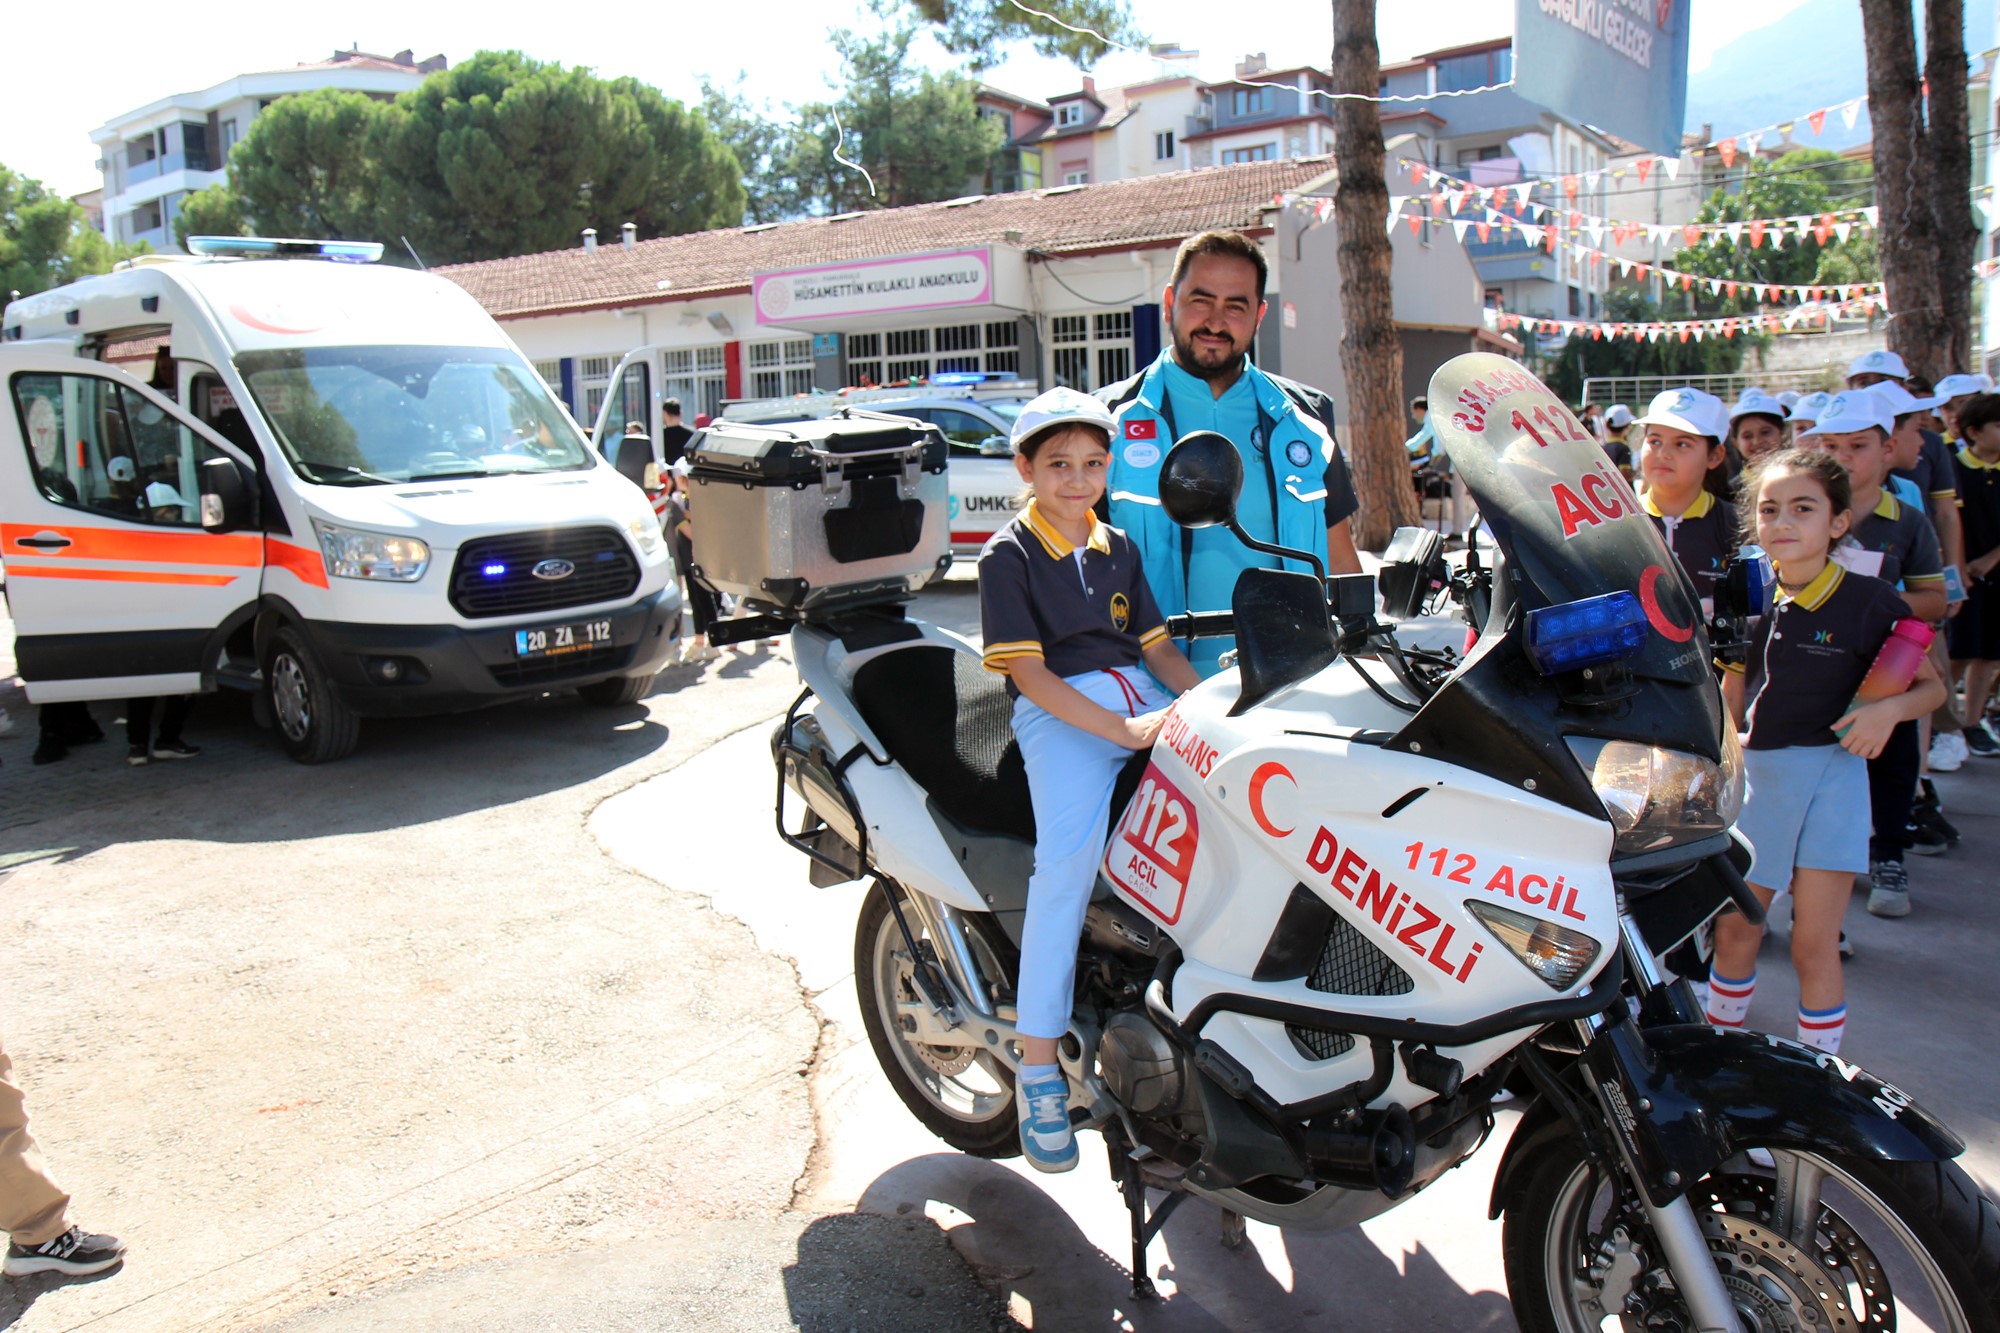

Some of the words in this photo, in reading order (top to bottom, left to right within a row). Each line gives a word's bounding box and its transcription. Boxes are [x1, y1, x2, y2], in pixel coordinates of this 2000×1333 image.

[1604, 9, 1652, 69] GELECEK
[794, 281, 864, 301] HÜSAMETTİN
[866, 276, 916, 295] KULAKLI
[919, 270, 979, 288] ANAOKULU
[1511, 404, 1588, 448] 112
[965, 496, 1018, 511] UMKE
[528, 630, 547, 651] 20
[555, 627, 574, 646] ZA
[587, 621, 610, 642] 112
[1129, 778, 1188, 867] 112
[1305, 825, 1484, 984] DENİZLİ
[1404, 841, 1477, 885] 112
[1484, 864, 1587, 922] ACİL
